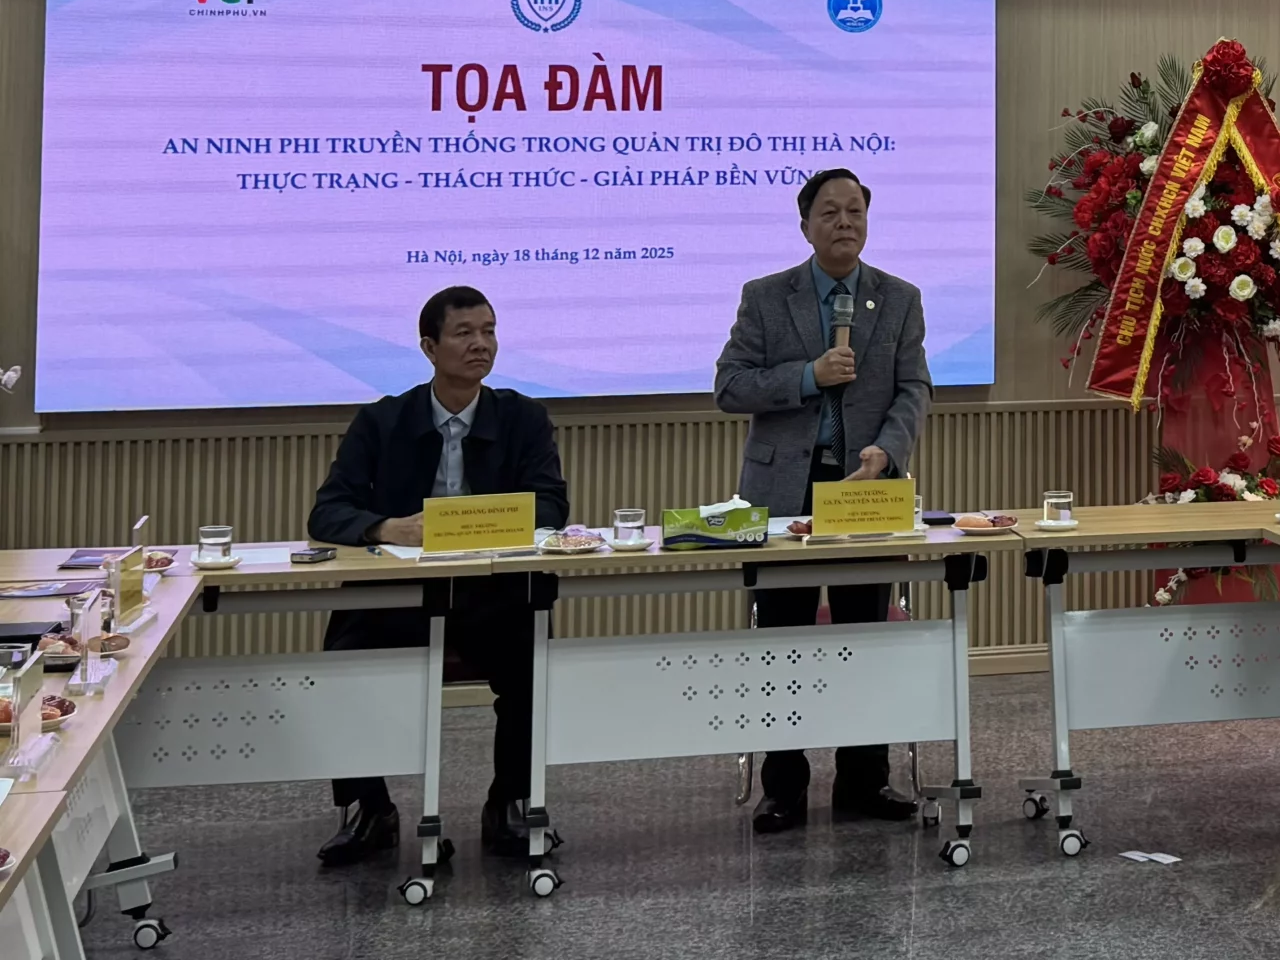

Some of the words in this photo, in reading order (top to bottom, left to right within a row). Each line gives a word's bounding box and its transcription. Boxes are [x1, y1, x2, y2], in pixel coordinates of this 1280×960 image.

[189, 9, 267, 17] CHINHPHU.VN
[422, 63, 527, 123] TỌA
[543, 52, 663, 112] ĐÀM
[163, 137, 199, 154] AN
[207, 137, 272, 154] NINH
[279, 137, 320, 154] PHI
[326, 130, 423, 154] TRUYỀN
[429, 129, 516, 154] THỐNG
[522, 136, 606, 153] TRONG
[612, 131, 680, 156] QUẢN
[686, 136, 722, 156] TRỊ
[728, 132, 762, 152] ĐÔ
[768, 136, 806, 156] THỊ
[812, 131, 844, 152] HÀ
[850, 132, 896, 155] NỘI:
[237, 172, 307, 194] THỰC
[313, 172, 399, 193] TRẠNG
[418, 168, 503, 188] THÁC
[509, 167, 575, 188] THỨC
[593, 166, 644, 187] GIẢI
[650, 166, 710, 186] PHÁP
[716, 162, 758, 186] BỀN
[764, 166, 823, 185] VỮN
[1125, 277, 1147, 311] TỊCH
[1148, 180, 1181, 236] CHXHCN
[1170, 147, 1195, 178] VIỆT
[1185, 113, 1211, 148] NAM
[407, 250, 429, 264] Hà
[434, 250, 467, 266] Nội,
[472, 250, 510, 267] ngày
[514, 249, 531, 262] 18
[536, 248, 580, 265] tháng
[584, 248, 600, 260] 12
[604, 247, 637, 260] năm
[641, 247, 675, 260] 2025
